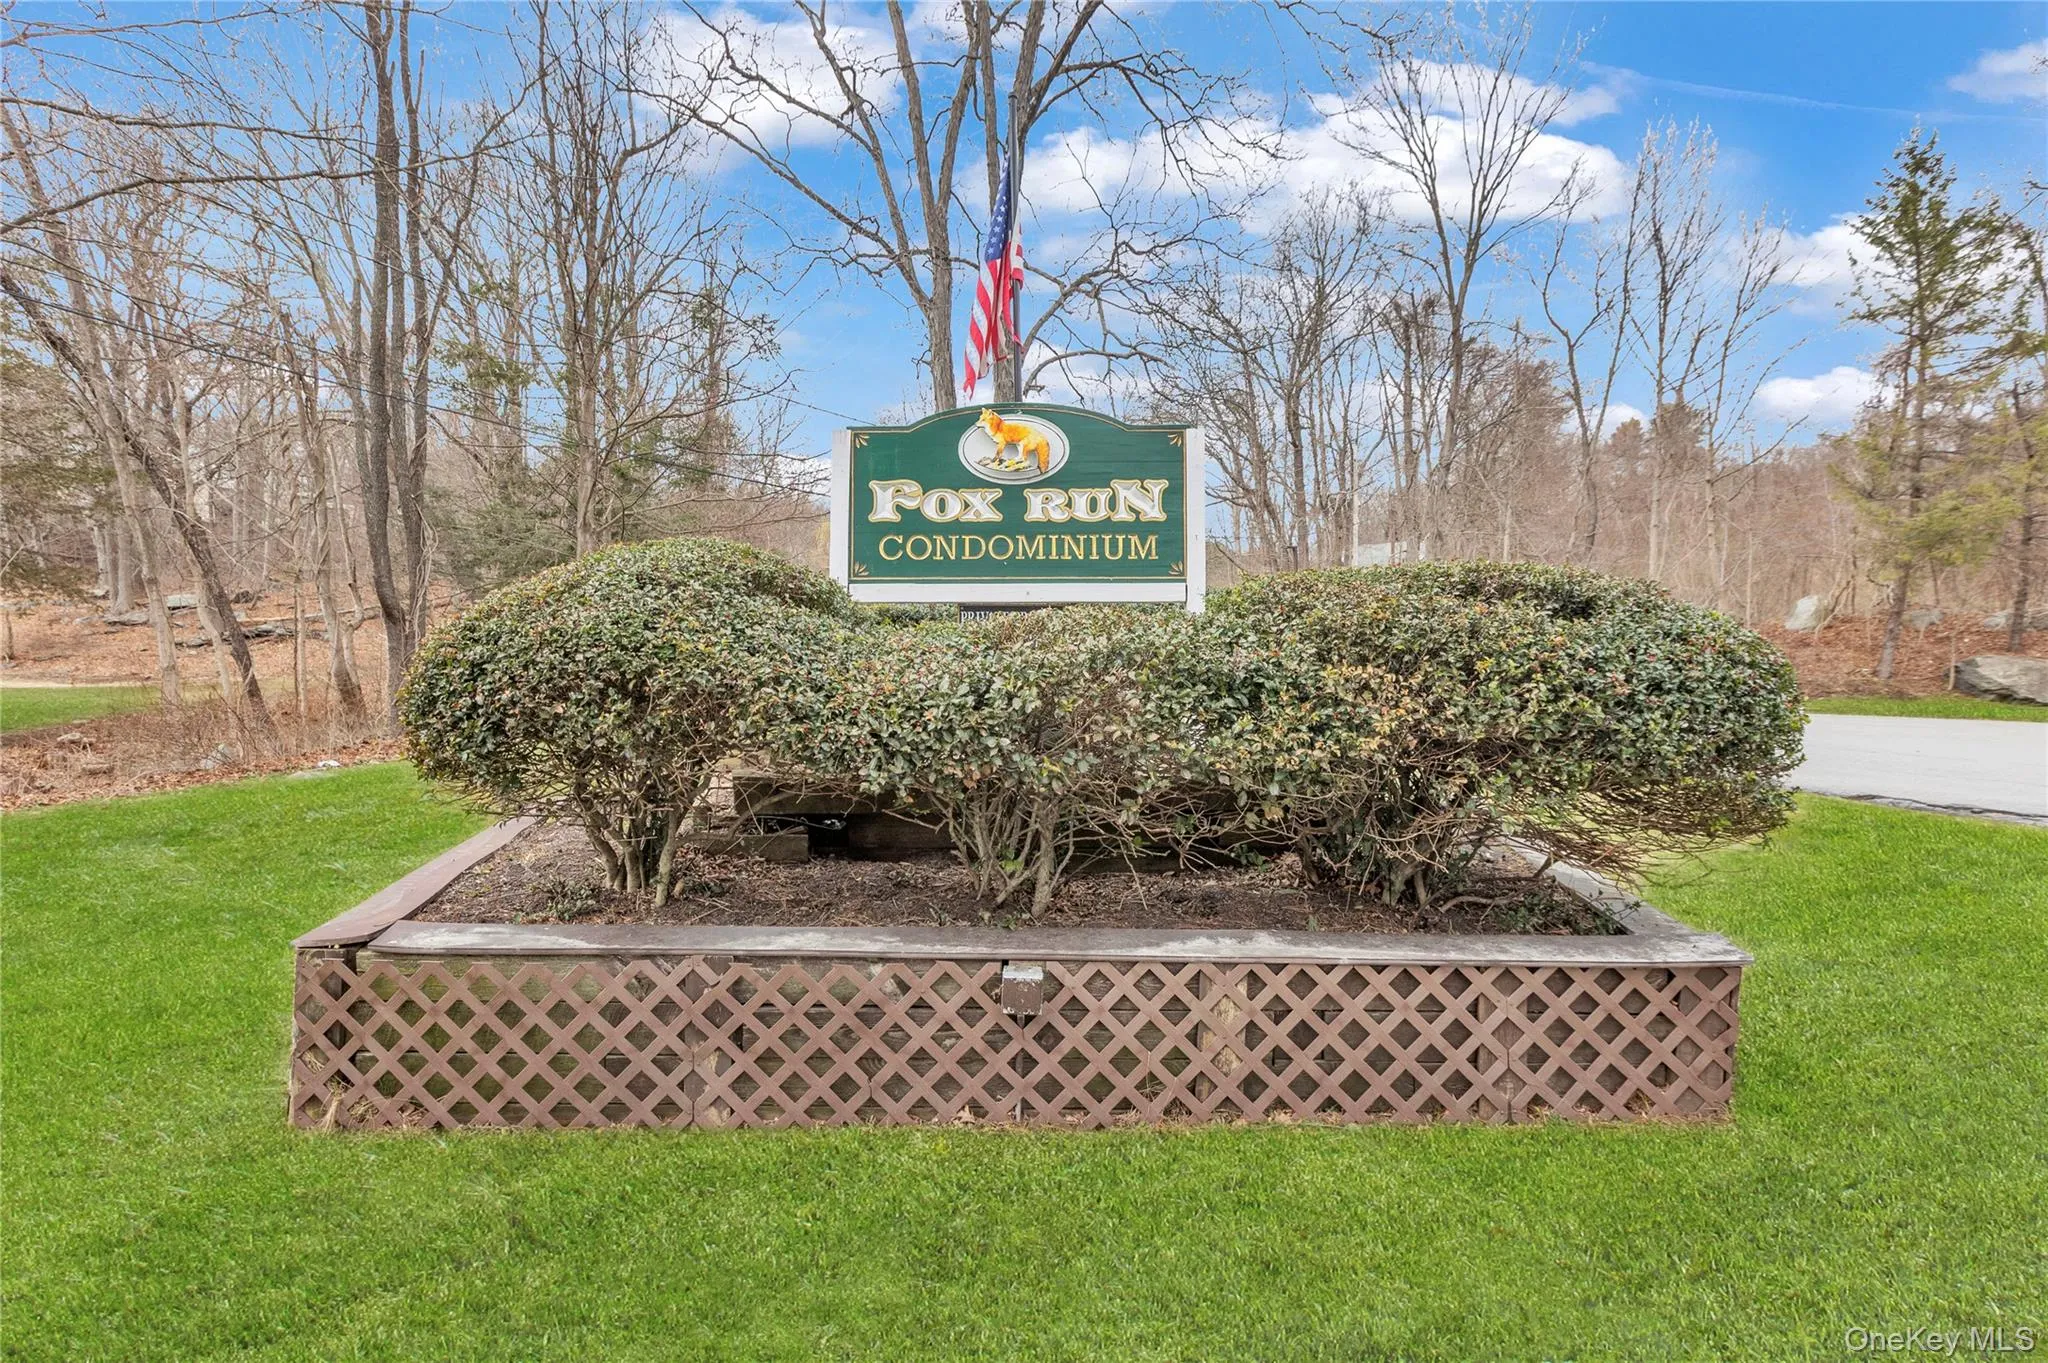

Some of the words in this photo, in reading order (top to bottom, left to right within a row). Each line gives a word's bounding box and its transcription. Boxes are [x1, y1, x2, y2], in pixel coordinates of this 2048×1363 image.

[868, 479, 1003, 523] FOX
[1023, 479, 1169, 523] RUN
[878, 534, 1159, 561] CONDOMINIUM
